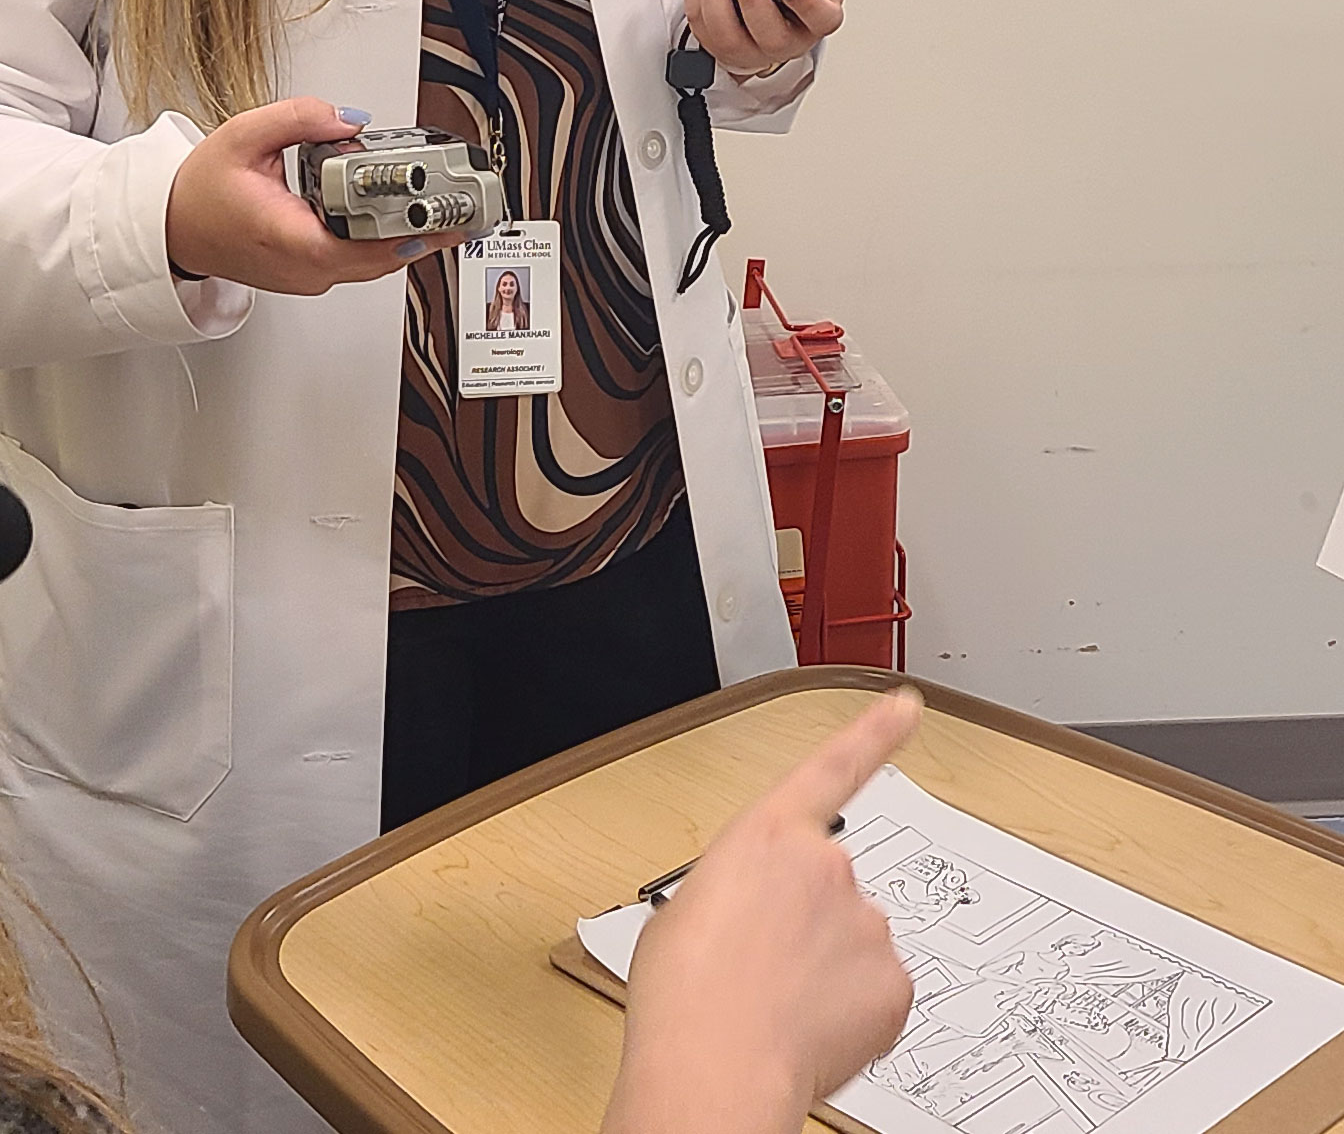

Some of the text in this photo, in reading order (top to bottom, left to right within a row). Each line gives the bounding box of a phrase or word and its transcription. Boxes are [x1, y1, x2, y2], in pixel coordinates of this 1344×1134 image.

[487, 239, 551, 251] UMass Chan
[466, 332, 506, 340] MICHELLE
